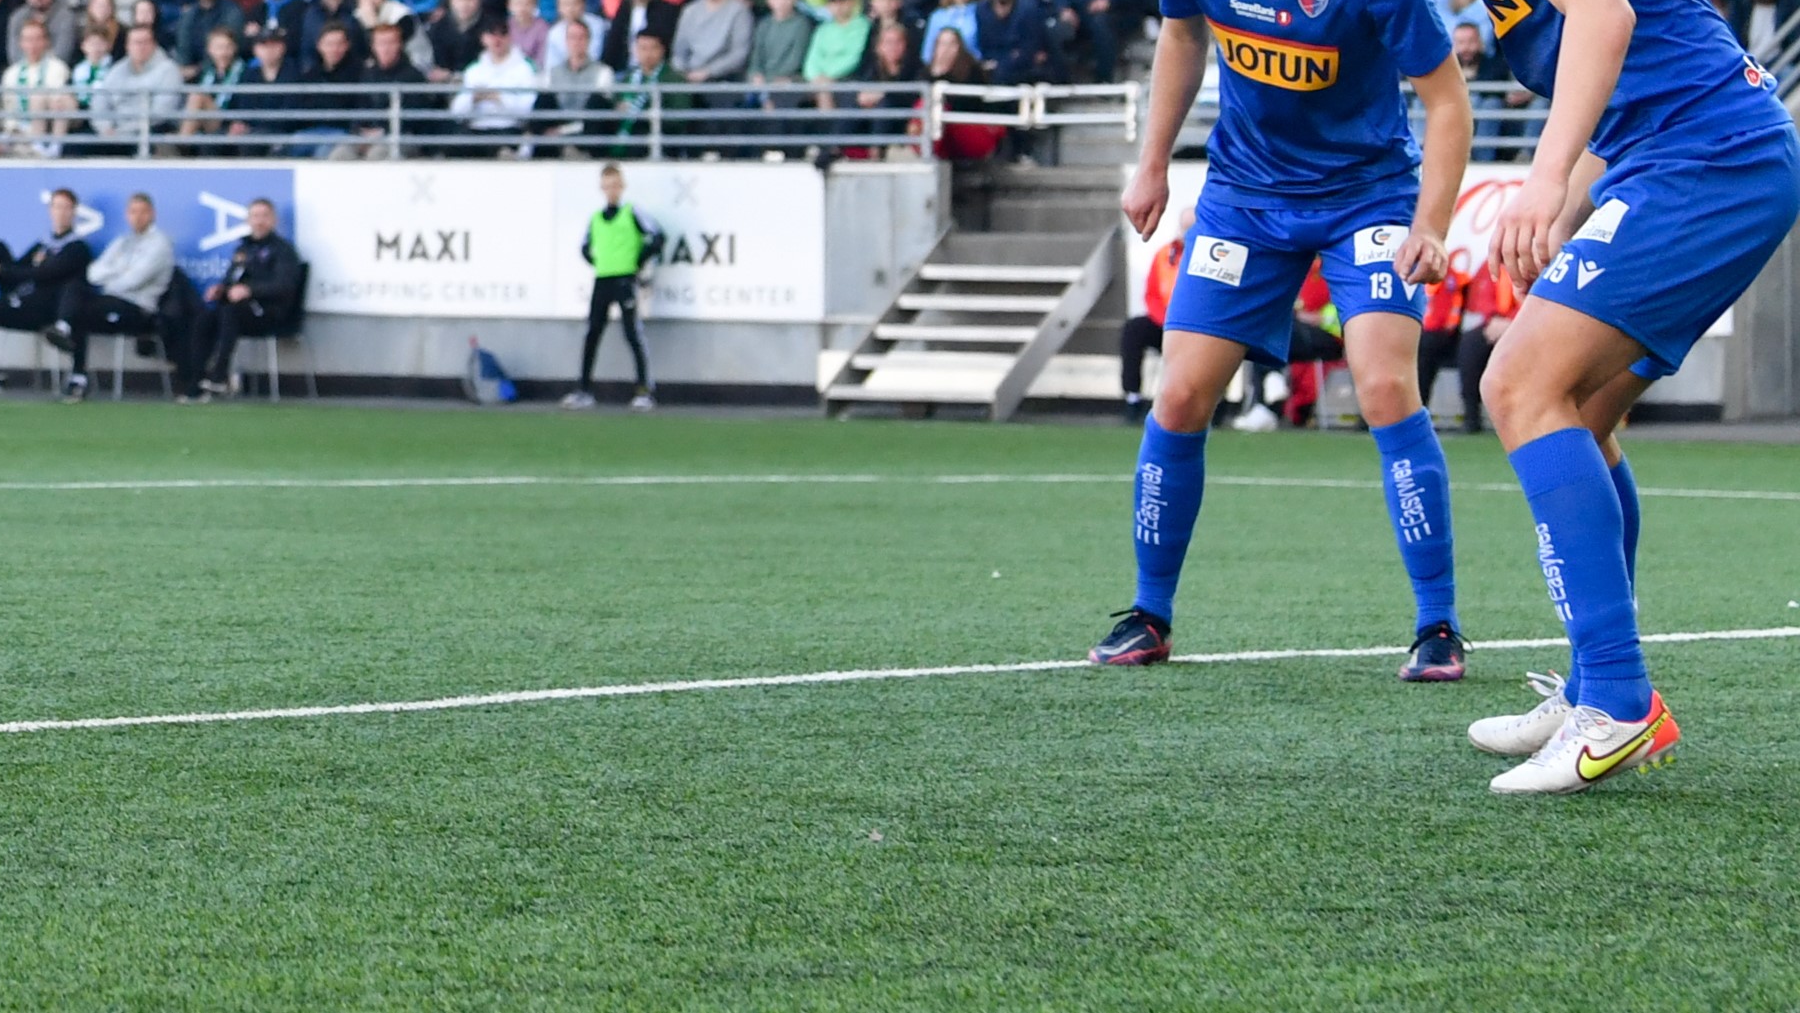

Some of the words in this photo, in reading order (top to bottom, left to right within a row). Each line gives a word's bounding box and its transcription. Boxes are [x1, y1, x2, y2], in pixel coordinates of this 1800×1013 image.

[1226, 38, 1331, 84] JOTUN
[375, 230, 470, 262] MAXI
[661, 233, 736, 265] AXI
[441, 281, 529, 302] CENTER
[1369, 272, 1393, 300] 13
